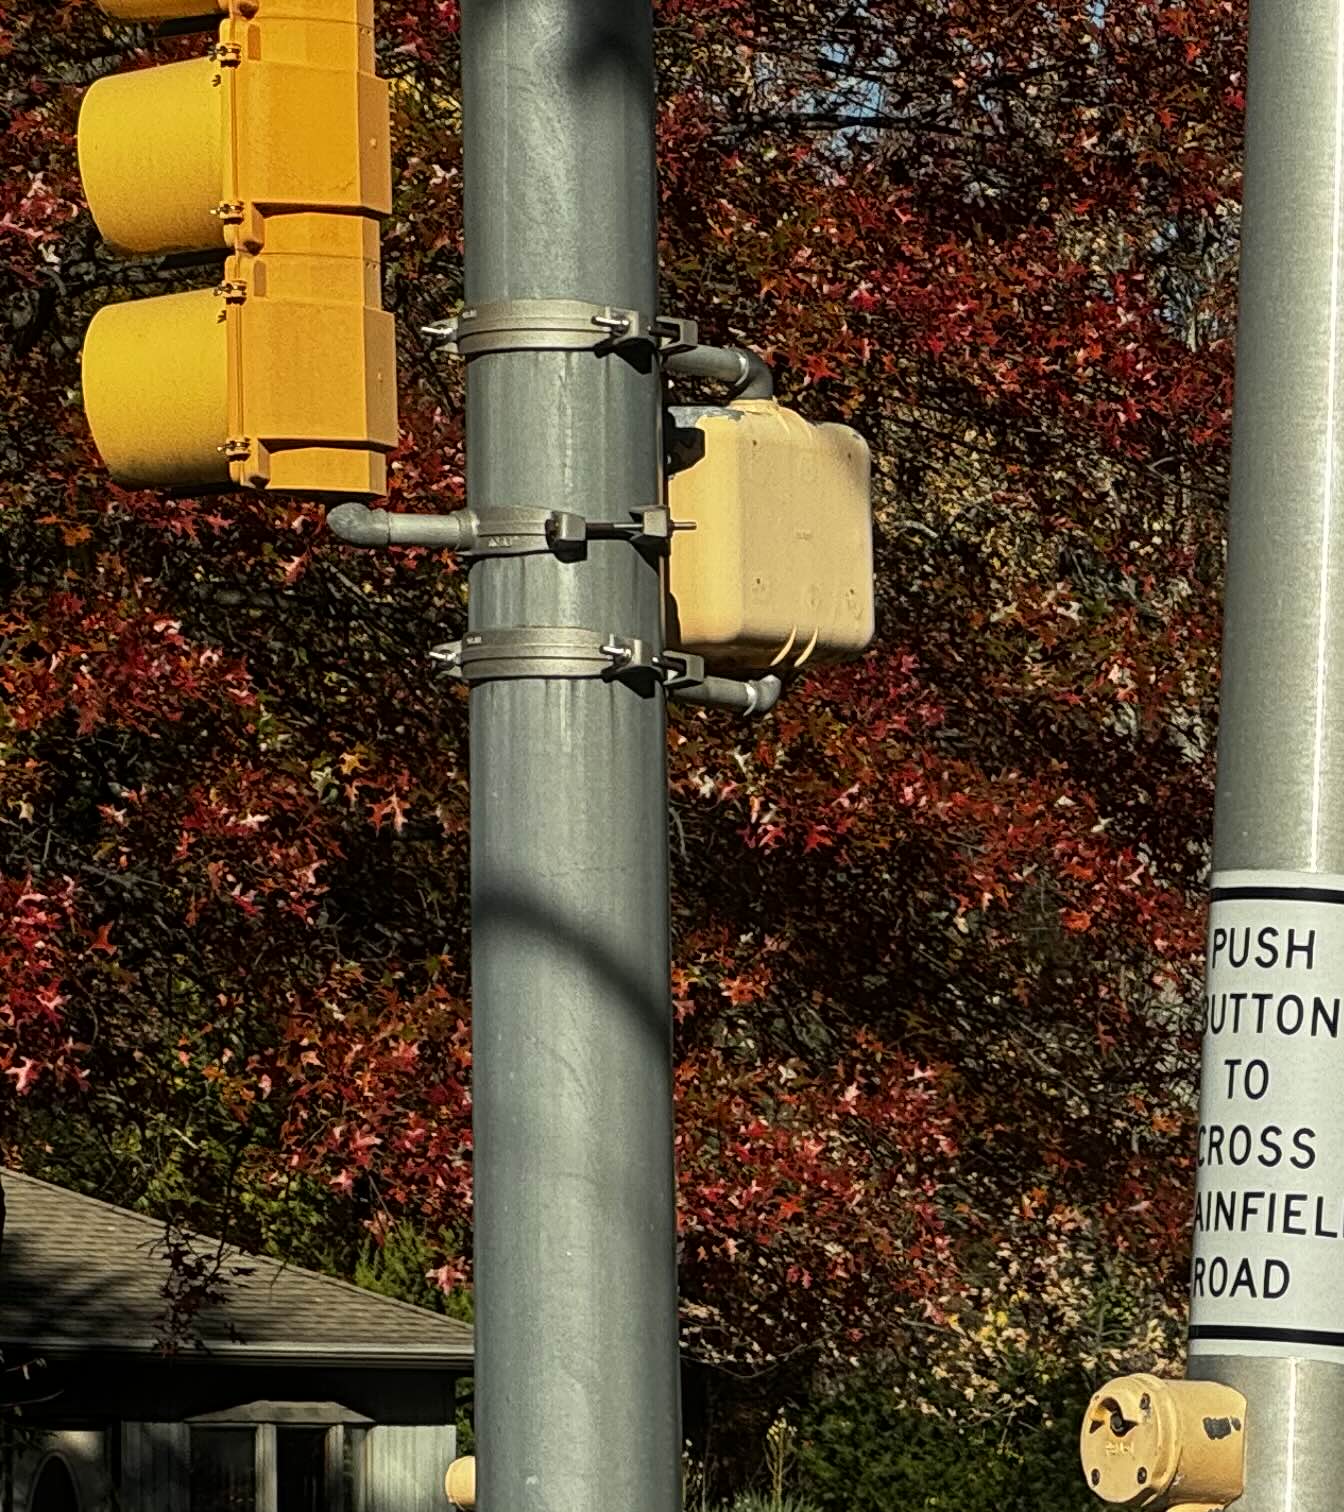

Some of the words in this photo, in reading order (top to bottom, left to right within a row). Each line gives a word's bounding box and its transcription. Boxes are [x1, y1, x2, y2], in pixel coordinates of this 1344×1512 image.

[1212, 926, 1316, 970] PUSH
[1223, 1058, 1269, 1101] TO
[1191, 1256, 1291, 1300] ROAD
